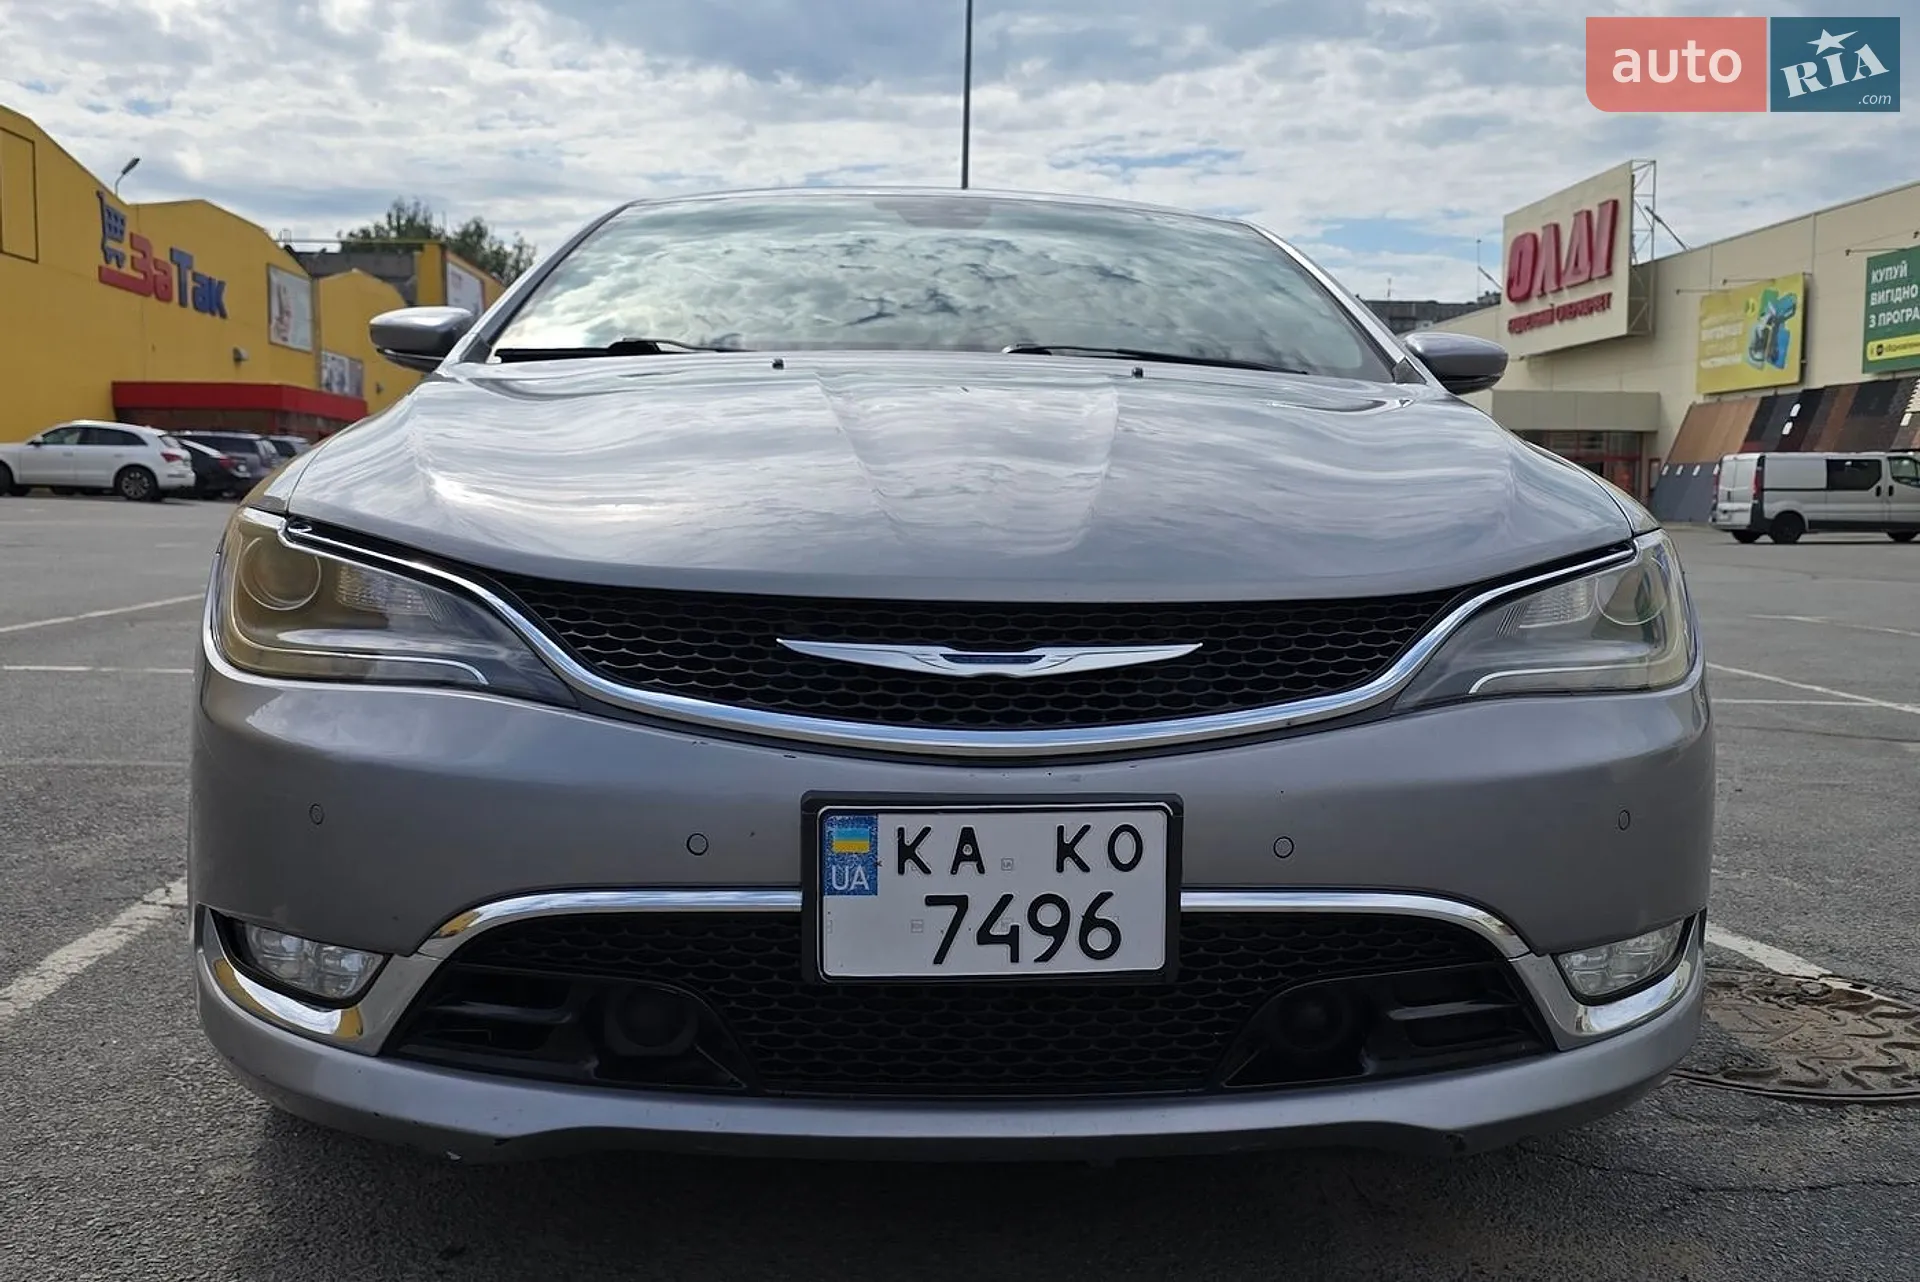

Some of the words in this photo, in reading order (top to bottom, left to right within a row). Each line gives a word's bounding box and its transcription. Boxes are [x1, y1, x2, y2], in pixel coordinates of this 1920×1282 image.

[1506, 198, 1619, 303] ОЛДІ
[1870, 260, 1909, 284] КУПУЙ
[1869, 284, 1919, 306] ВИГІДНО
[831, 865, 870, 891] UA
[923, 891, 1122, 965] 7496
